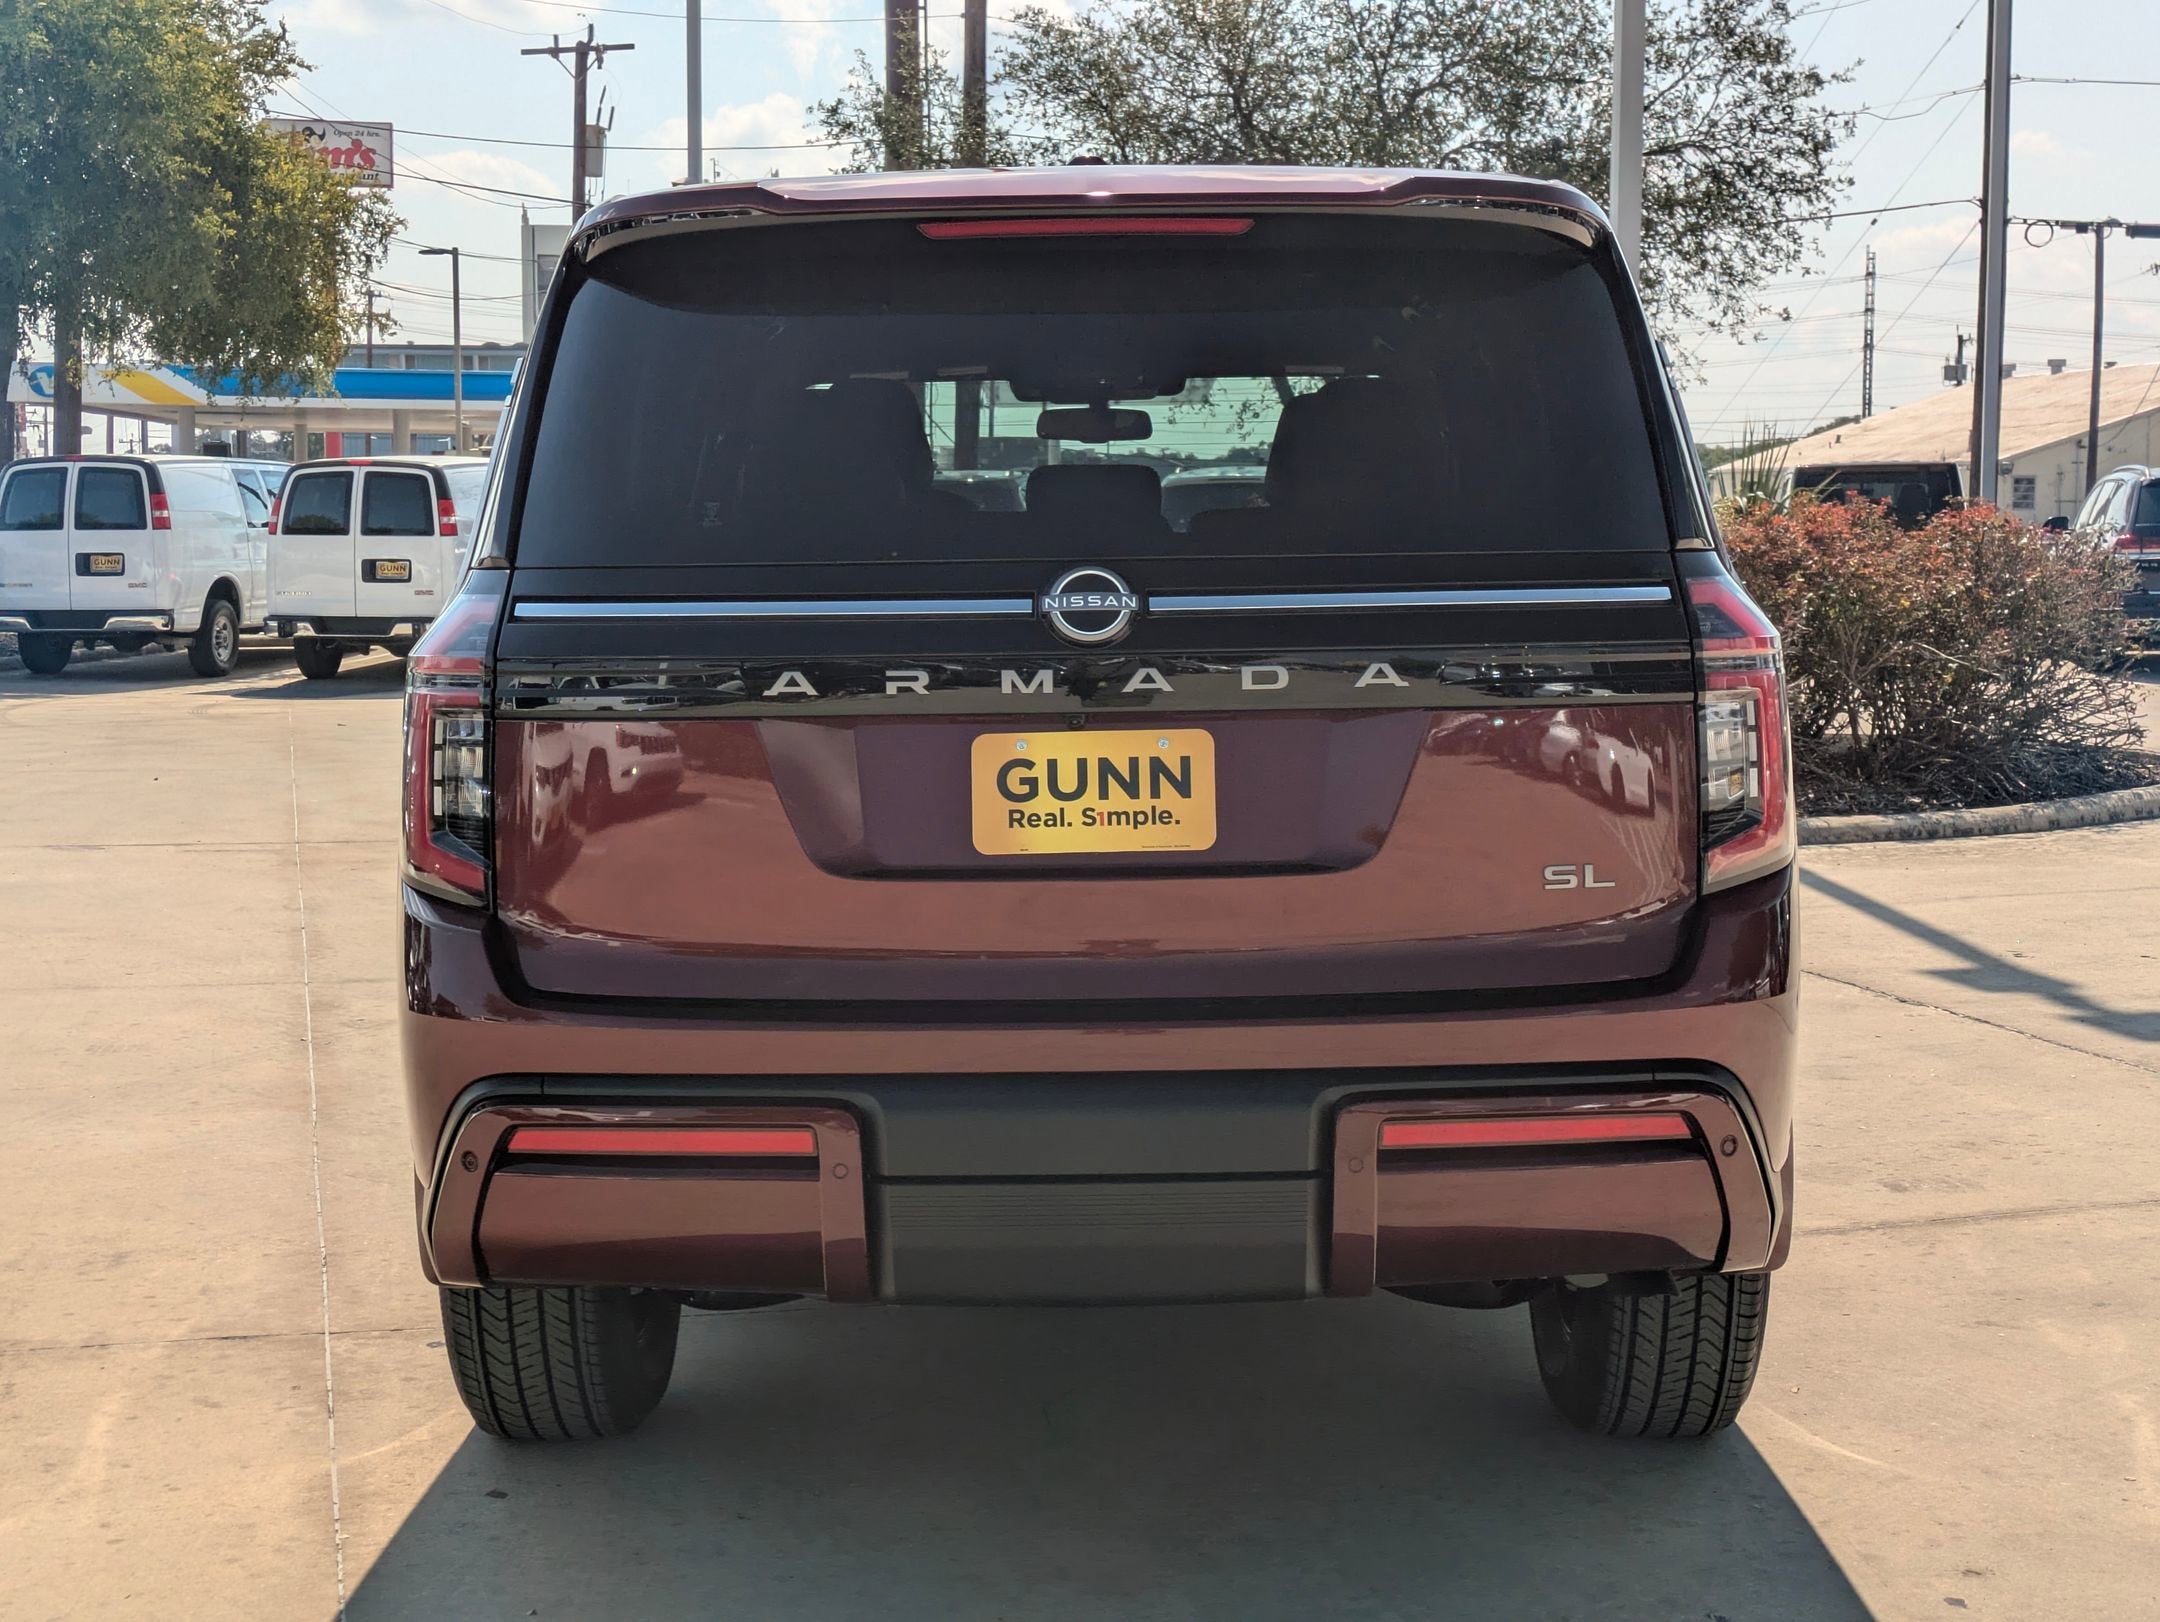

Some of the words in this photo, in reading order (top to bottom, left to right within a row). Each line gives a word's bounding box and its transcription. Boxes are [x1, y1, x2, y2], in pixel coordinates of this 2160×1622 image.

[333, 129, 353, 138] Open
[94, 558, 120, 566] GUNN
[380, 564, 406, 572] GUNN
[1045, 595, 1136, 609] NISSAN
[762, 663, 1410, 697] ARMADA
[996, 755, 1192, 803] GUNN
[1008, 807, 1073, 829] Real.
[1544, 864, 1616, 890] SL
